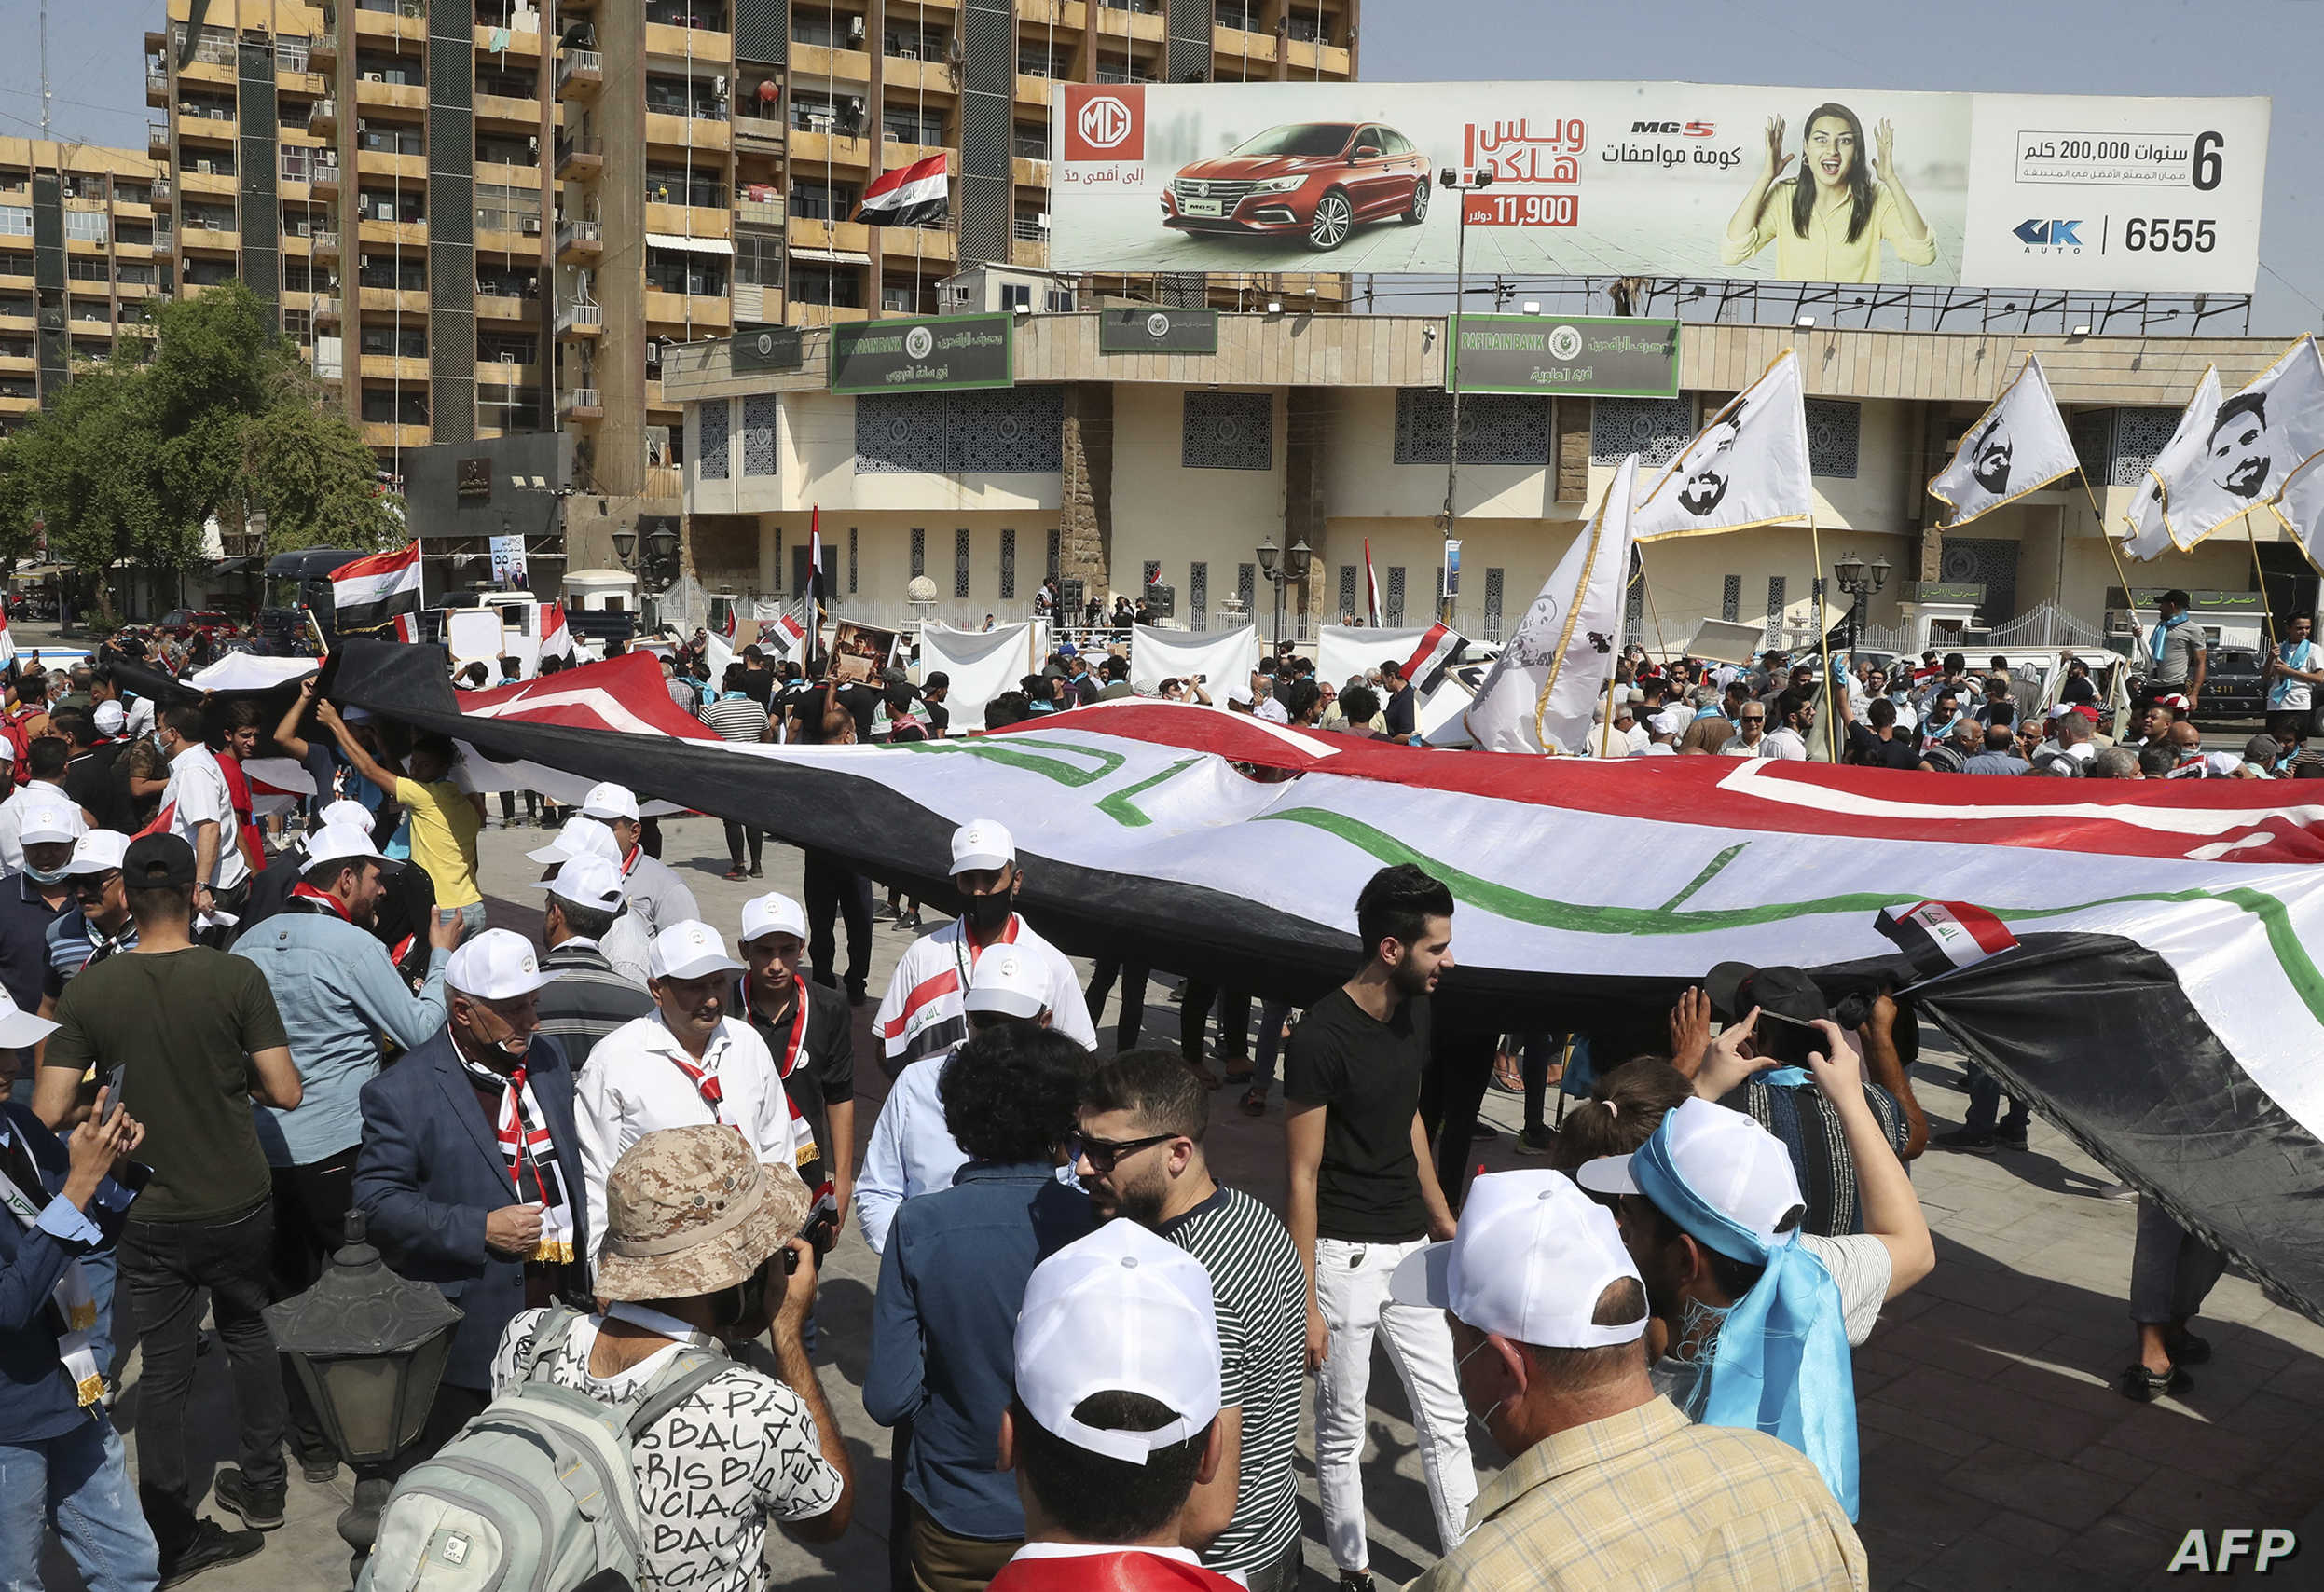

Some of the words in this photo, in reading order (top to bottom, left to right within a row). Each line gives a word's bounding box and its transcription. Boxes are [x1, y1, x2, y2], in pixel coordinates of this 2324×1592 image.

[1081, 102, 1125, 143] MG
[1630, 121, 1715, 137] MG5
[1602, 143, 1686, 168] مواصفات
[1693, 145, 1742, 170] كومة
[2024, 142, 2055, 160] كلم
[2059, 140, 2130, 161] 200,000
[2134, 144, 2188, 163] سنوات
[2193, 130, 2224, 191] 6
[1122, 167, 1145, 185] إلى
[1467, 210, 1492, 223] دولار
[1493, 196, 1573, 226] 11,900
[2125, 217, 2217, 253] 6555
[2024, 246, 2081, 254] AUTO
[1461, 332, 1513, 350] RAFIDAIN
[1513, 333, 1545, 351] BANK
[2199, 591, 2257, 605] مصرف
